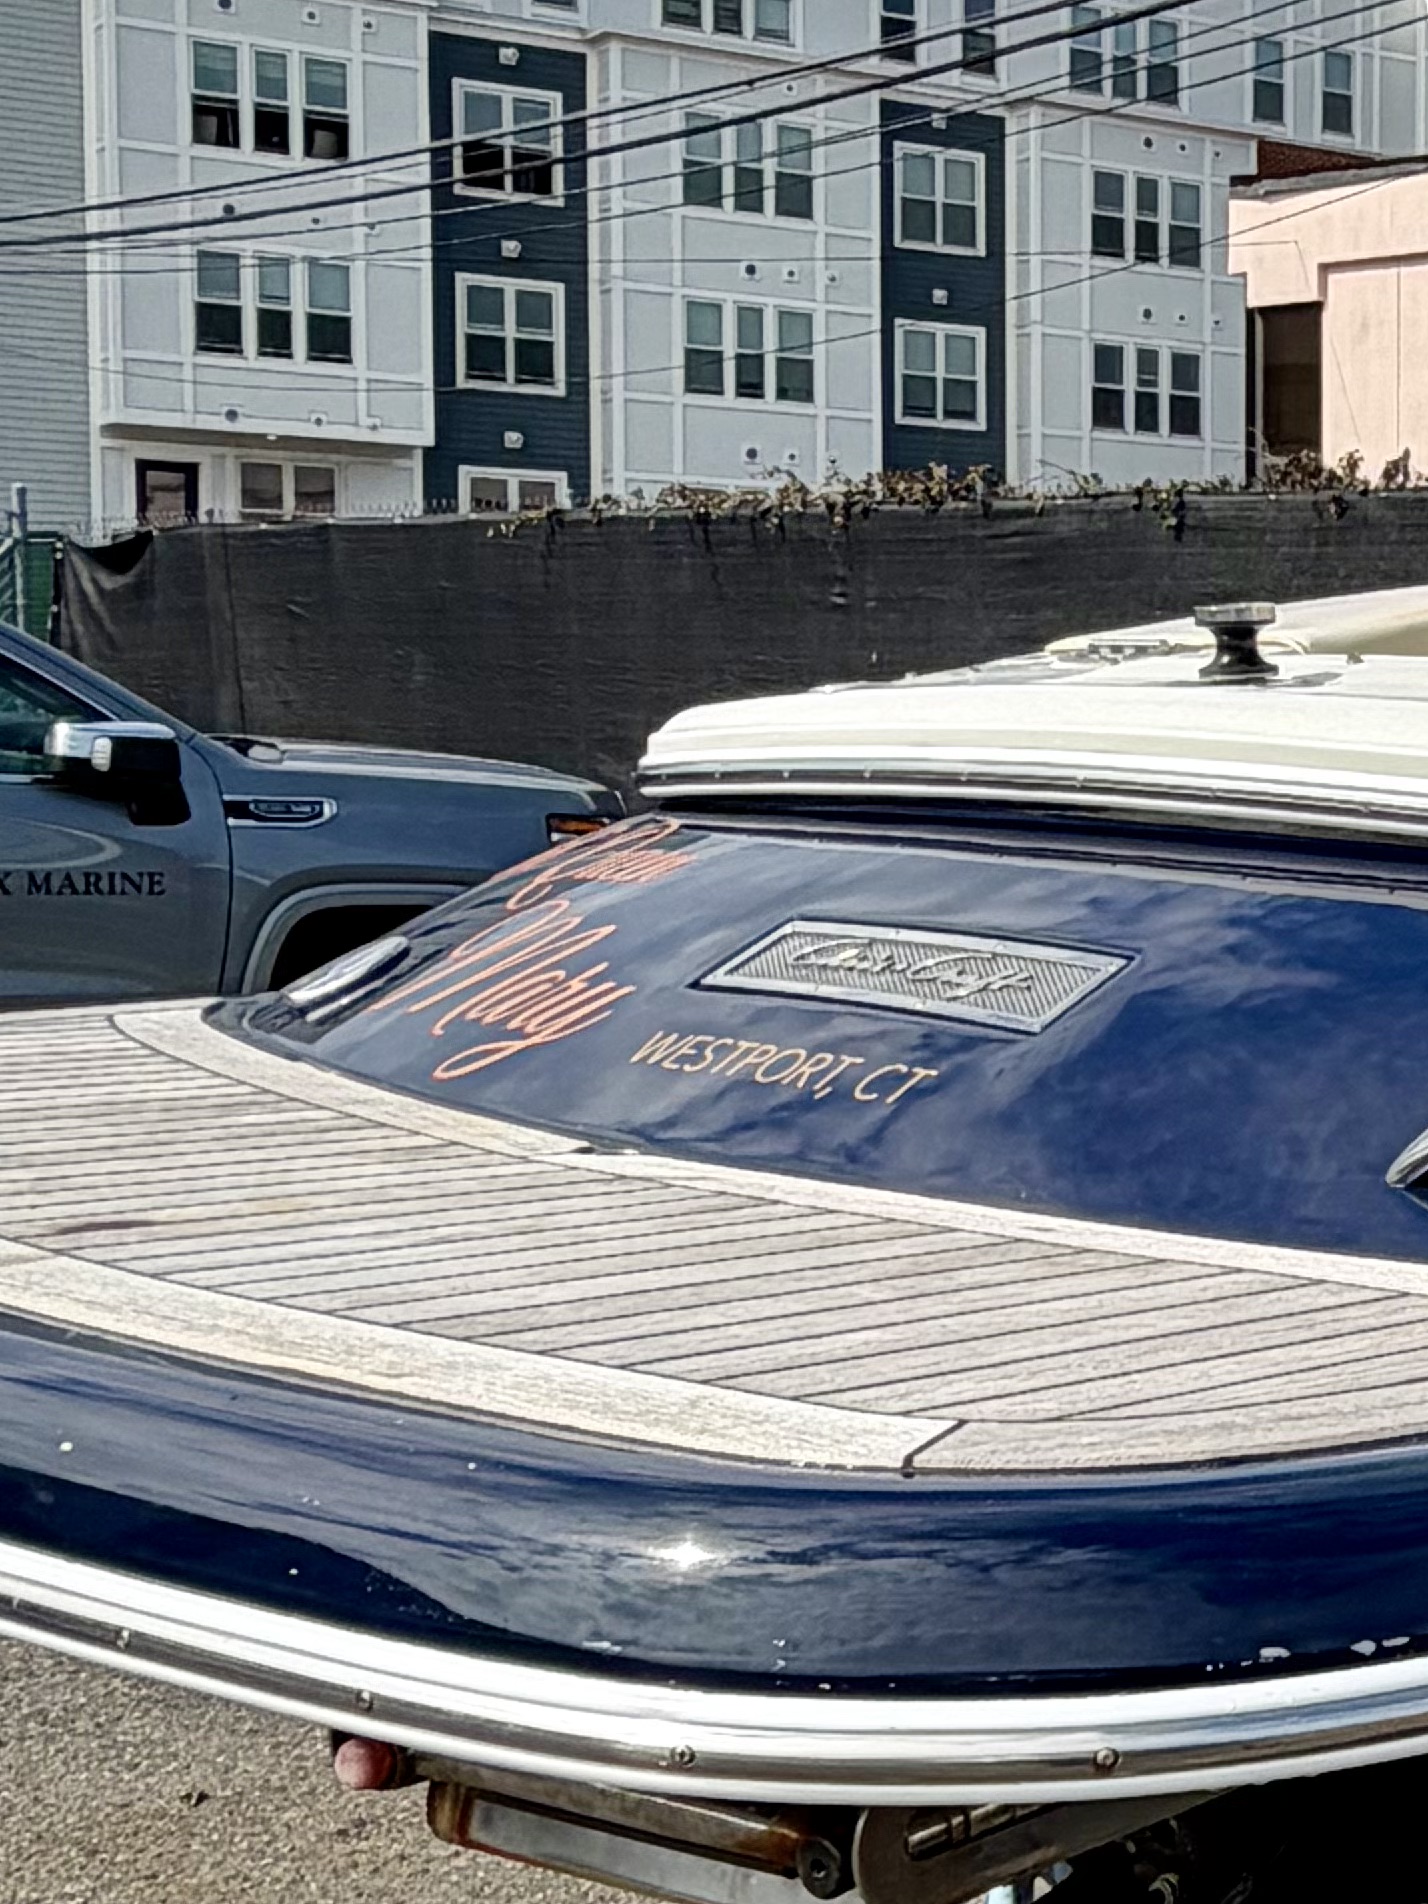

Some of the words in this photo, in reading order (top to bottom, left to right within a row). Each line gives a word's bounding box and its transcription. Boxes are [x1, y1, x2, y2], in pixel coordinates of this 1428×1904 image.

[27, 871, 165, 896] MARINE
[363, 898, 638, 1081] Mary
[629, 1030, 865, 1100] WESTPORT,
[854, 1063, 939, 1105] CT
